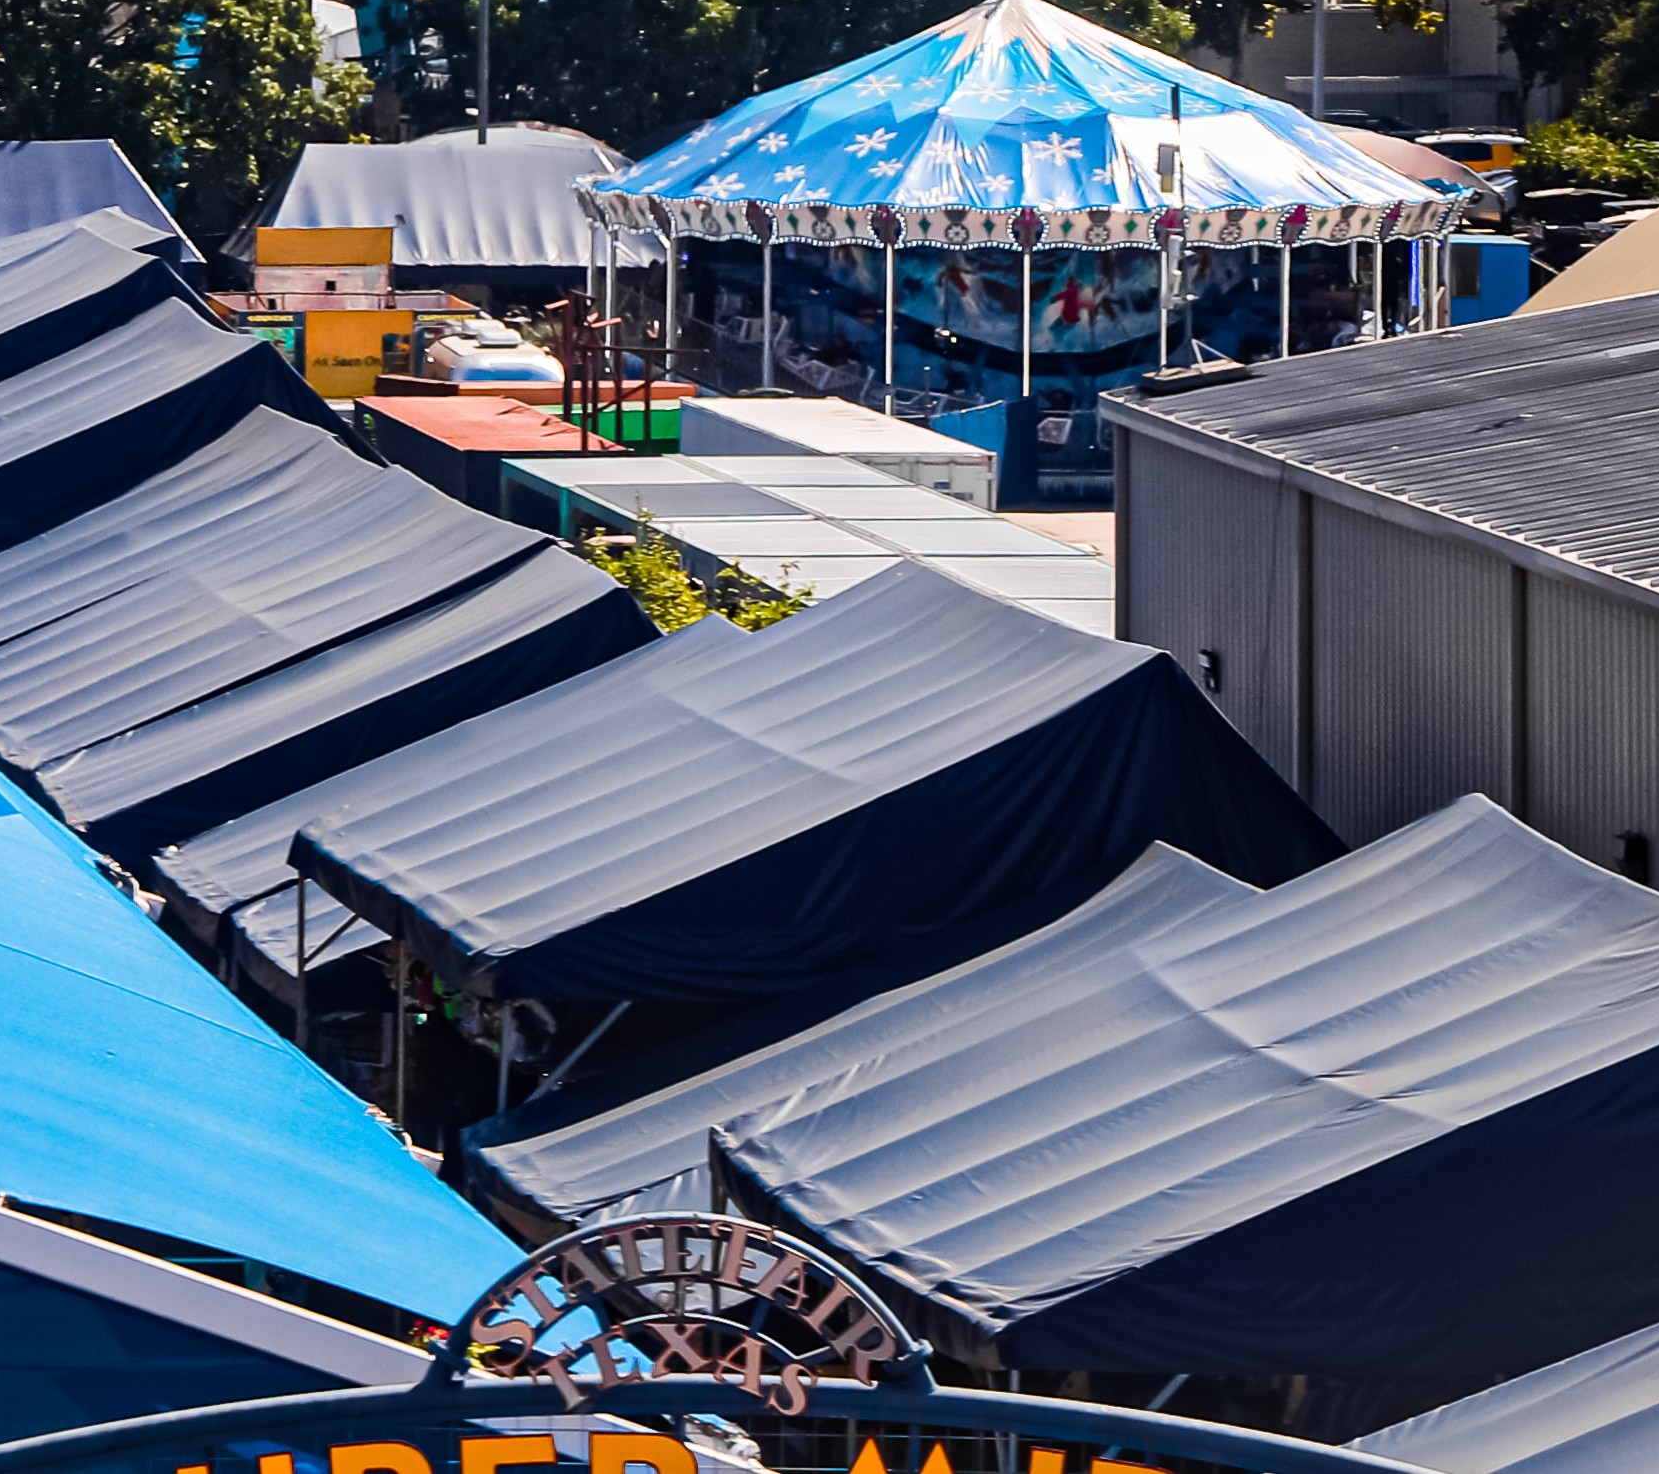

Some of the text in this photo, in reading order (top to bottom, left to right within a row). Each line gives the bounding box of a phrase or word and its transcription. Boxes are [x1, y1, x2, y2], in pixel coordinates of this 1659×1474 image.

[469, 1219, 898, 1386] STATE FAIR
[530, 1322, 817, 1416] TEXAS
